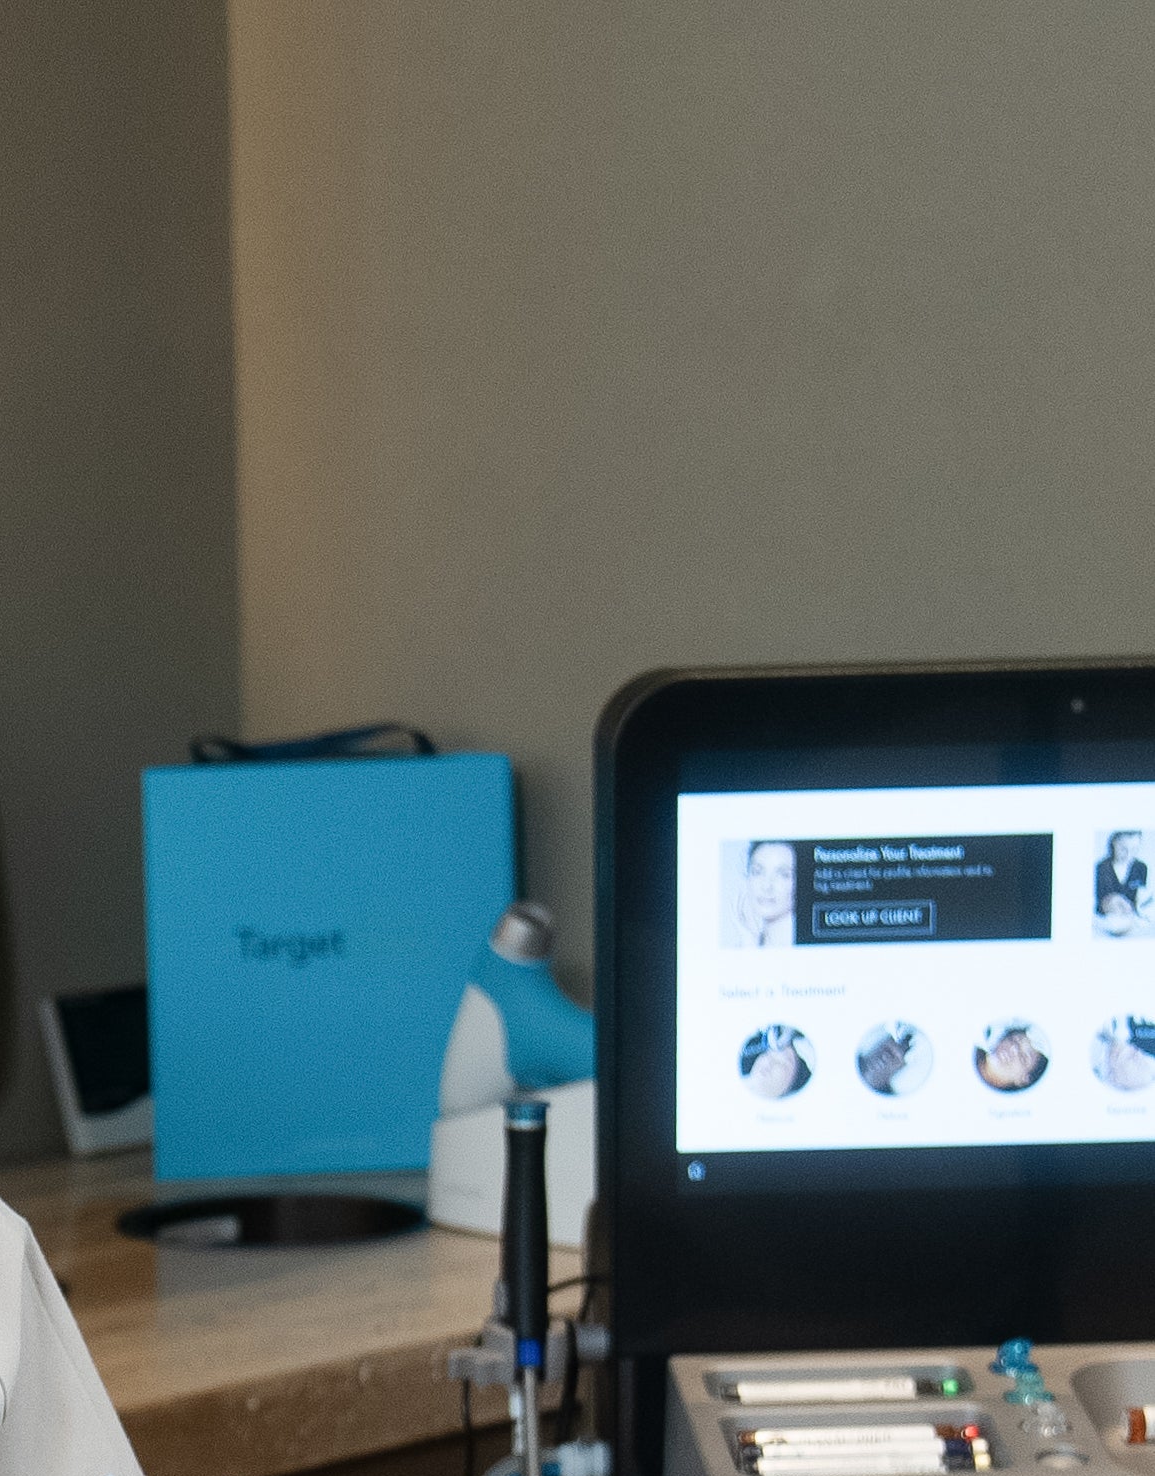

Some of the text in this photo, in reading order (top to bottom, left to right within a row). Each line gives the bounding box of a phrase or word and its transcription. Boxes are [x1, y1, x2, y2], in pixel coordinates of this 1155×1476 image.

[881, 845, 907, 862] Your
[908, 843, 964, 862] Treatment
[824, 908, 922, 926] LOOK UP CLIENT
[233, 925, 346, 969] Target
